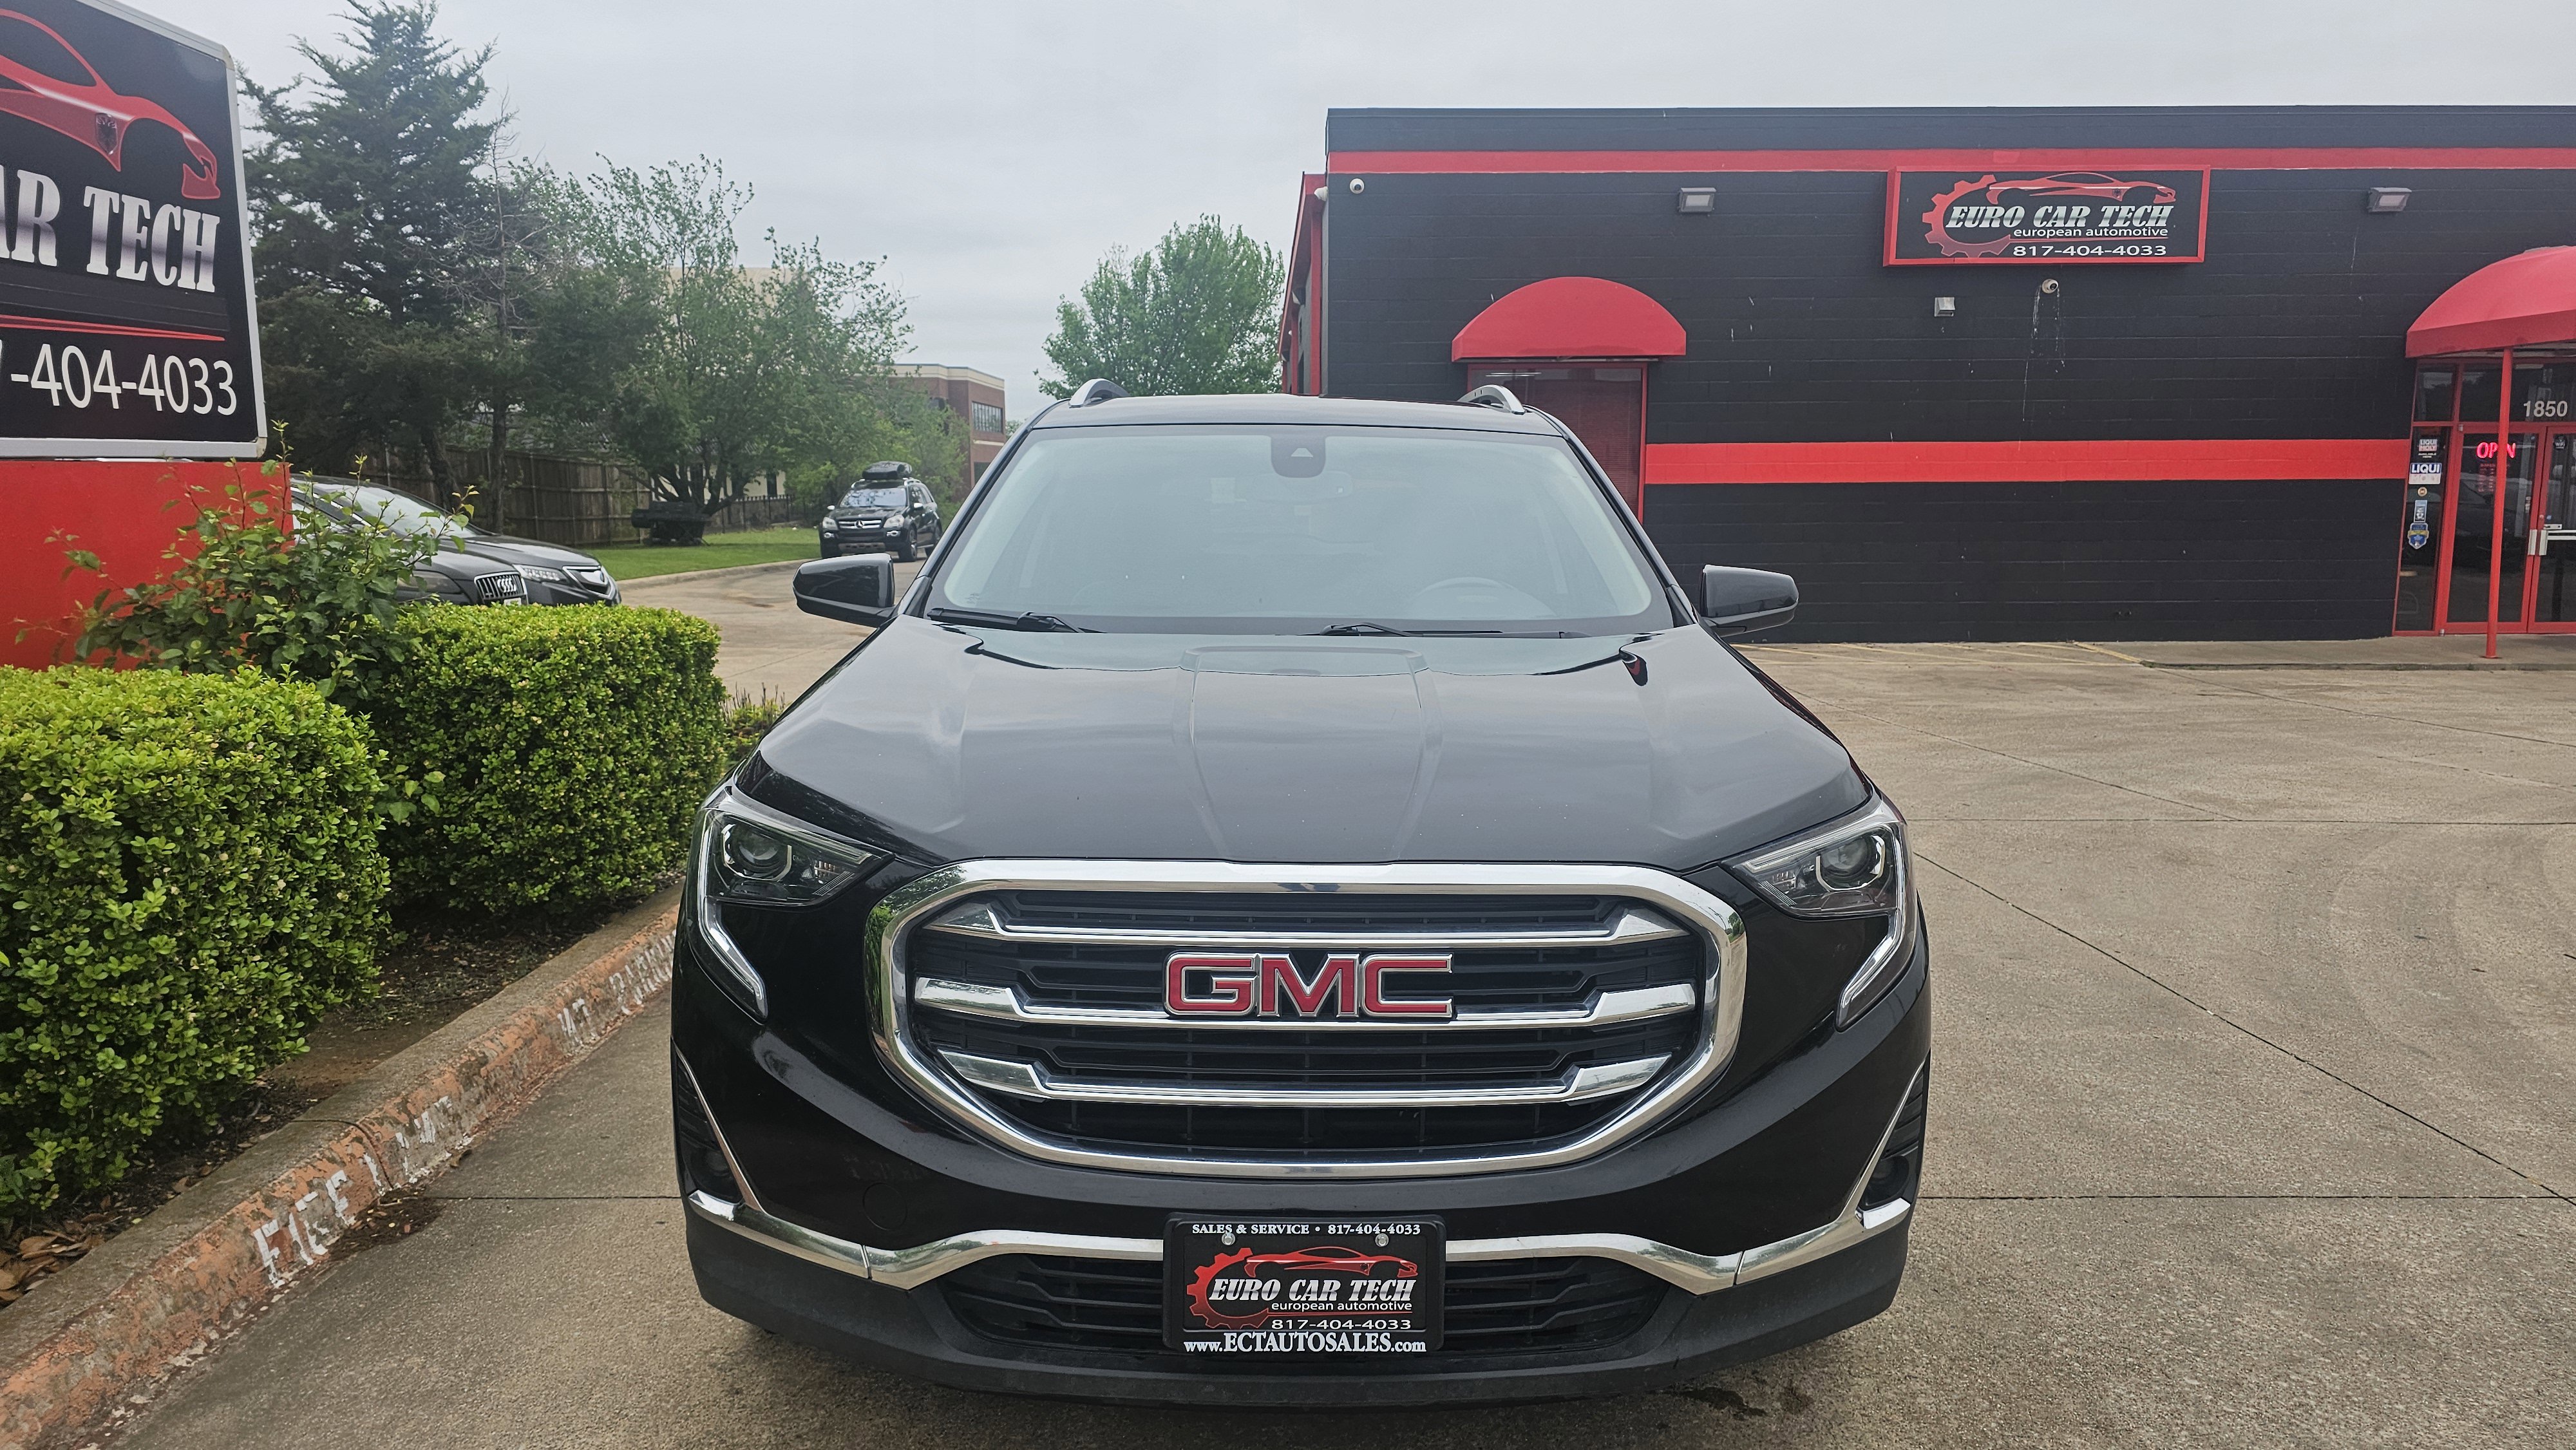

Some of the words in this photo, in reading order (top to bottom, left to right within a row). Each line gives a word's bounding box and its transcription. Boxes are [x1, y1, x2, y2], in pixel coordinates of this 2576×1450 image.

[1946, 205, 2025, 228] EURO
[2033, 205, 2092, 227] CAR
[2098, 205, 2174, 227] TECH
[84, 186, 220, 292] TECH
[2013, 227, 2081, 238] european
[2085, 227, 2168, 237] automotive
[2013, 245, 2167, 256] 817-404-4033
[0, 340, 237, 416] -404-4033
[2523, 400, 2568, 417] 1850
[2476, 442, 2516, 458] OPN
[2411, 464, 2440, 474] LIQUI
[1163, 952, 1453, 1018] GMC
[1192, 1224, 1233, 1235] SALES
[1236, 1224, 1245, 1234] &
[1251, 1224, 1310, 1235] SERVICE
[1327, 1224, 1421, 1235] 817-404-4033
[1209, 1278, 1281, 1301] EURO
[1289, 1278, 1345, 1301] CAR
[1349, 1279, 1416, 1301] TECH
[1271, 1301, 1334, 1312] european
[1337, 1301, 1412, 1312] automotive
[1271, 1319, 1411, 1330] 817-404-4033
[1183, 1331, 1427, 1353] www.ECTAUTOSALES.com
